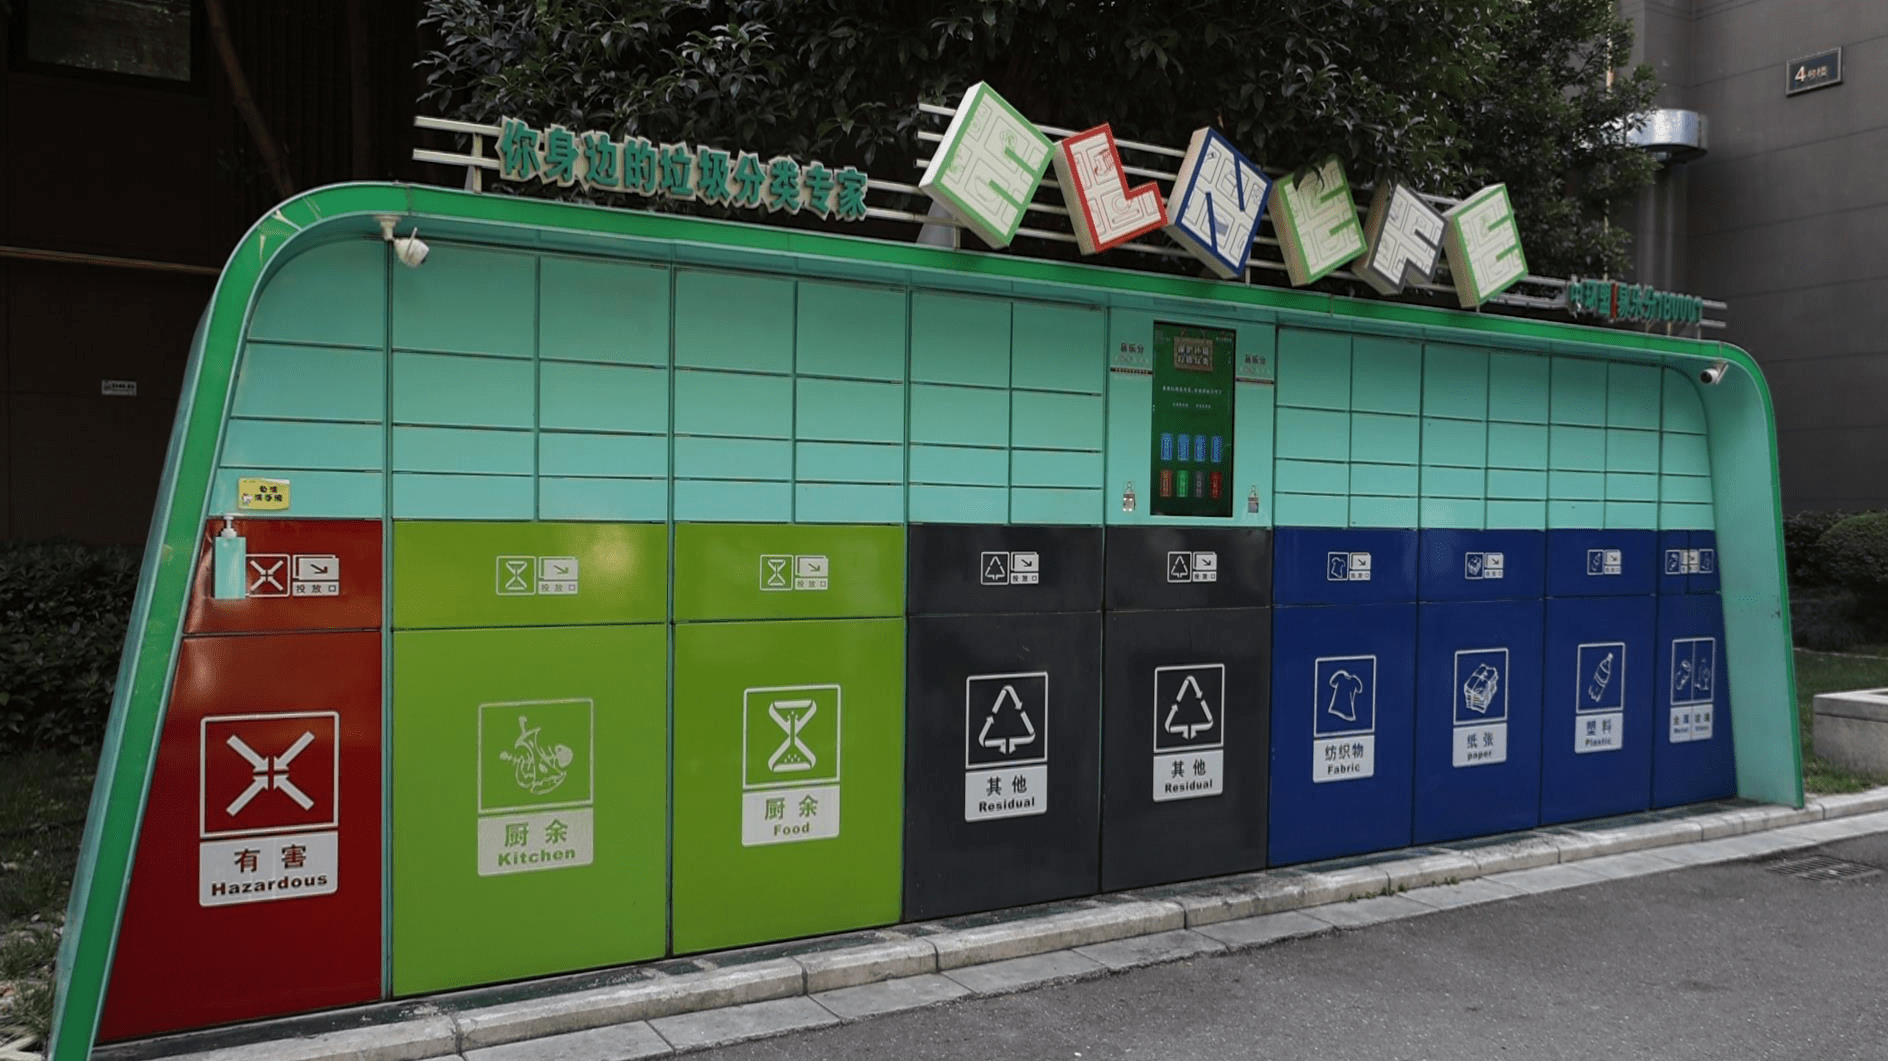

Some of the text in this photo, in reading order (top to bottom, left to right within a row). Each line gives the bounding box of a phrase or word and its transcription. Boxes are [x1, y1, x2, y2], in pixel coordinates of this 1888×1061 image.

[498, 116, 868, 221] 你身边的垃圾分类专家
[296, 584, 336, 594] 投放口
[1467, 732, 1493, 749] 纸张
[1325, 742, 1364, 761] 纺织物
[1171, 759, 1206, 778] 其他
[1328, 763, 1360, 775] Fabric
[986, 774, 1027, 796] 其他
[1165, 778, 1212, 793] Residual
[765, 795, 818, 820] 厨余
[979, 796, 1035, 812] Residual
[505, 819, 568, 847] 厨余
[774, 822, 810, 836] Food
[234, 844, 306, 874] 有害
[498, 849, 576, 866] Kitchen
[211, 874, 328, 896] Hazardous
